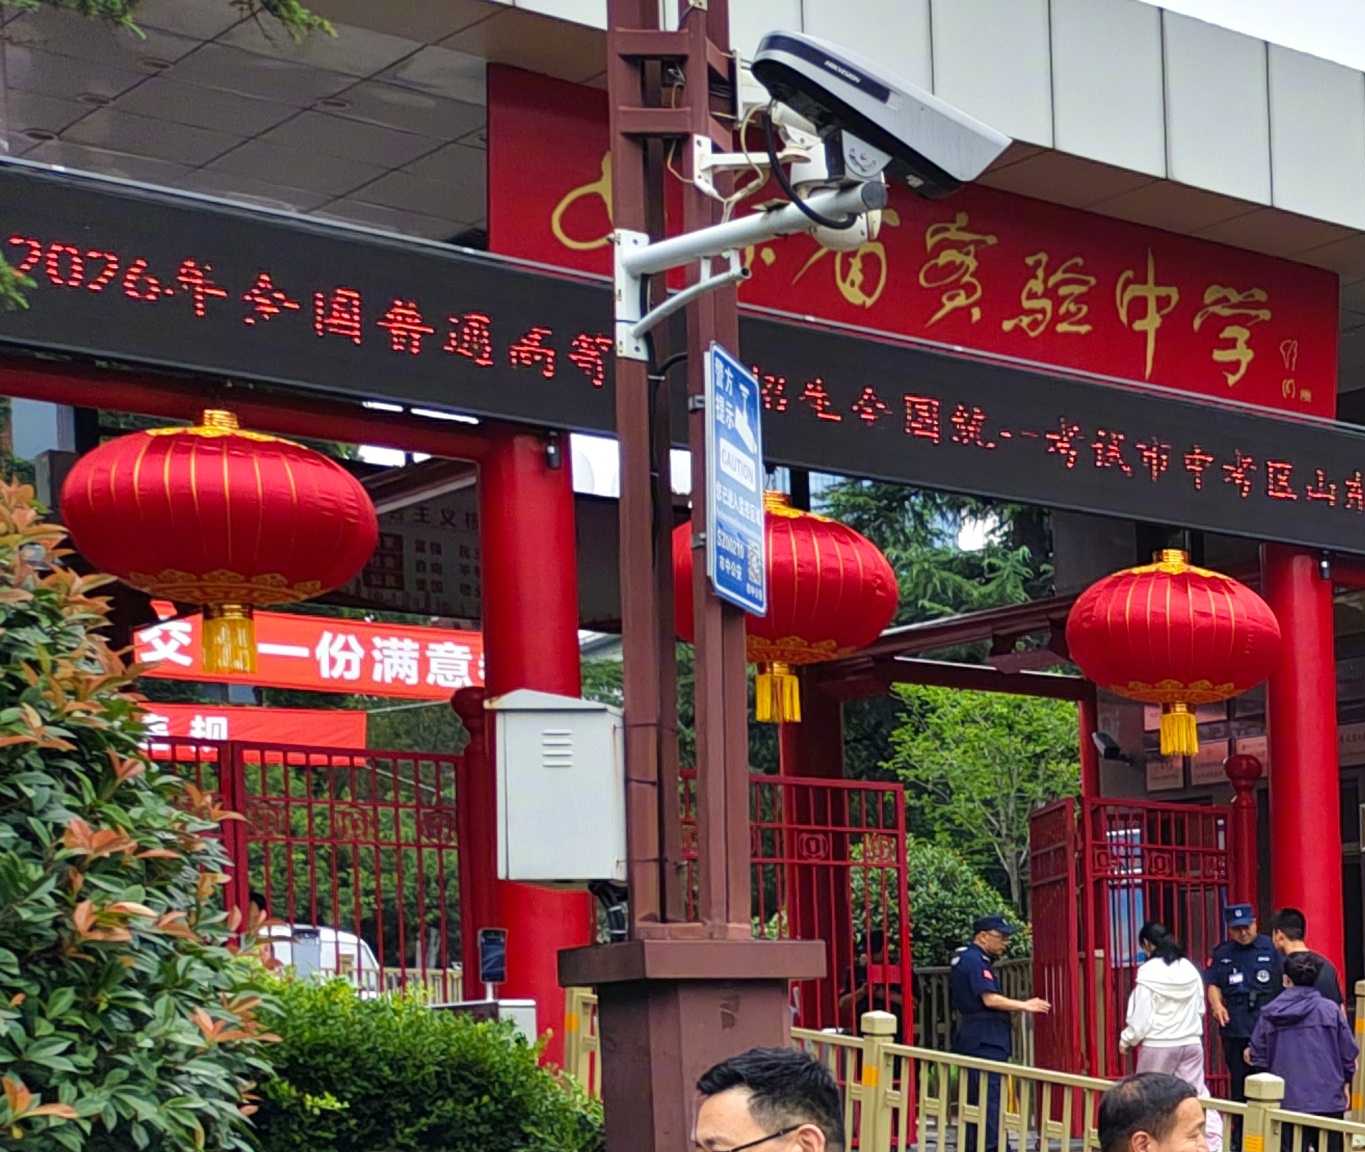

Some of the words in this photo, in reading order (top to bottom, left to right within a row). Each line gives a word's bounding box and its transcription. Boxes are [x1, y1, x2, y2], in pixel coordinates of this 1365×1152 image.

[721, 447, 754, 485] CAUTION
[138, 620, 487, 688] 交一份满意
